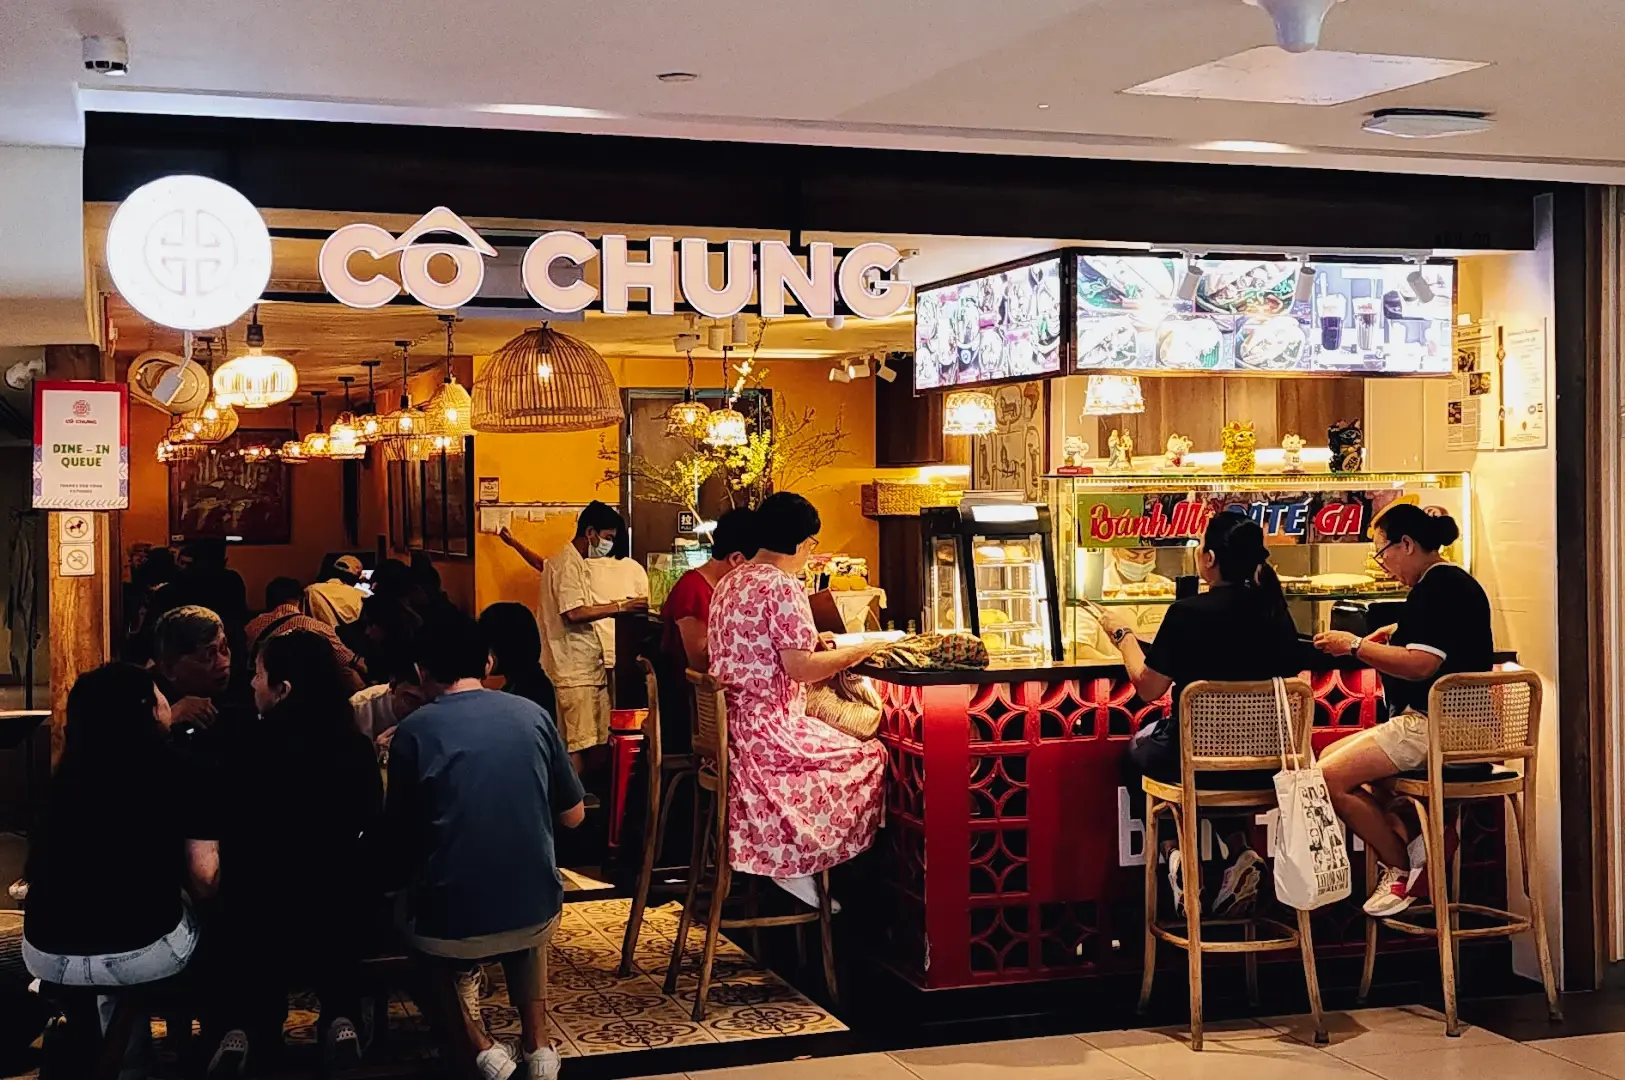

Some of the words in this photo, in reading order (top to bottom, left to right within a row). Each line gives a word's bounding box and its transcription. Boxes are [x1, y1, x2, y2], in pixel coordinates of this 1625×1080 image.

[318, 206, 498, 309] CÔ
[521, 231, 913, 319] CHUNG
[53, 444, 83, 453] DINE
[95, 444, 110, 454] IN
[61, 457, 102, 468] QUEUE
